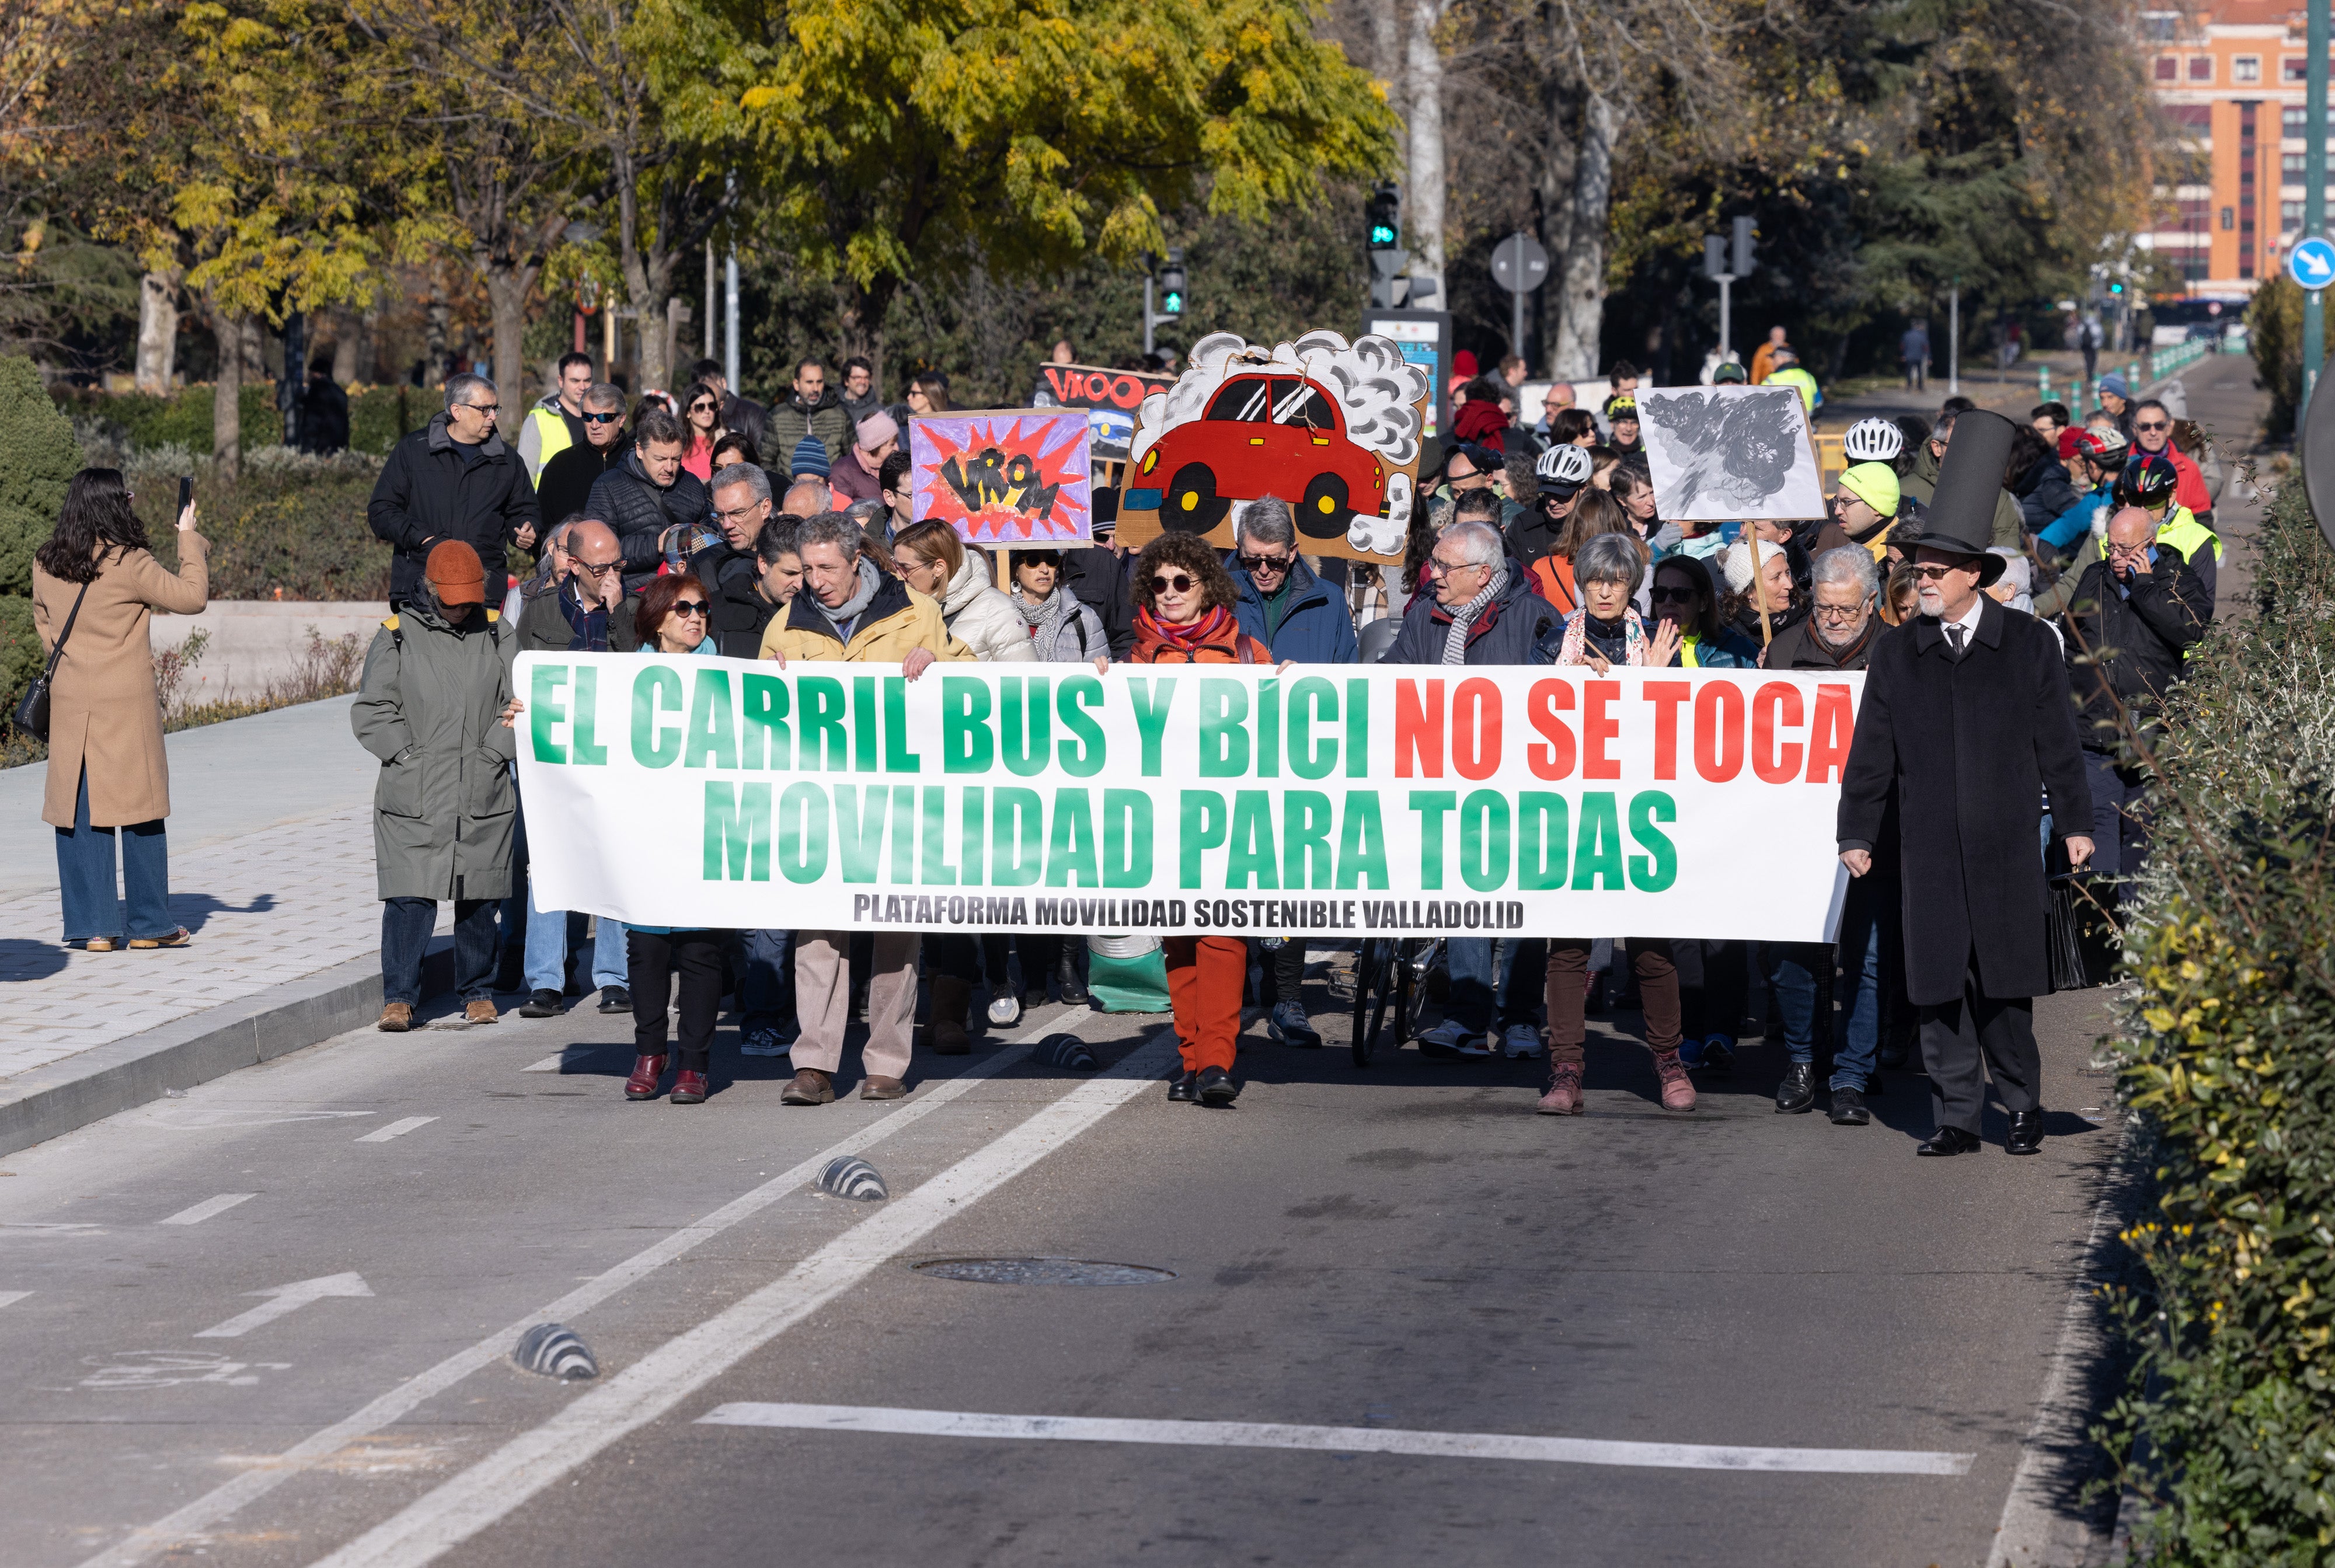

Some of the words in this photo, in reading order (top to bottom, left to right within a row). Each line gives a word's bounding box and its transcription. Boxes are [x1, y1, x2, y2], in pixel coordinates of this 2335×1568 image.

[531, 664, 607, 765] EL
[630, 665, 921, 773] CARRIL
[942, 675, 1106, 778] BUS
[1127, 677, 1177, 777] Y
[1199, 676, 1369, 780] BICI
[1395, 677, 1503, 780] NO
[1527, 678, 1621, 782] SE
[1643, 680, 1856, 785] TOCA
[703, 780, 1153, 889] MOVILIDAD
[1179, 789, 1390, 890] PARA
[1409, 788, 1678, 893] TODAS
[853, 894, 1028, 926] PLATAFORMA
[1035, 897, 1187, 927] MOVILIDAD
[1194, 899, 1355, 928] SOSTENIBLE
[1362, 900, 1524, 929] VALLADOLID
